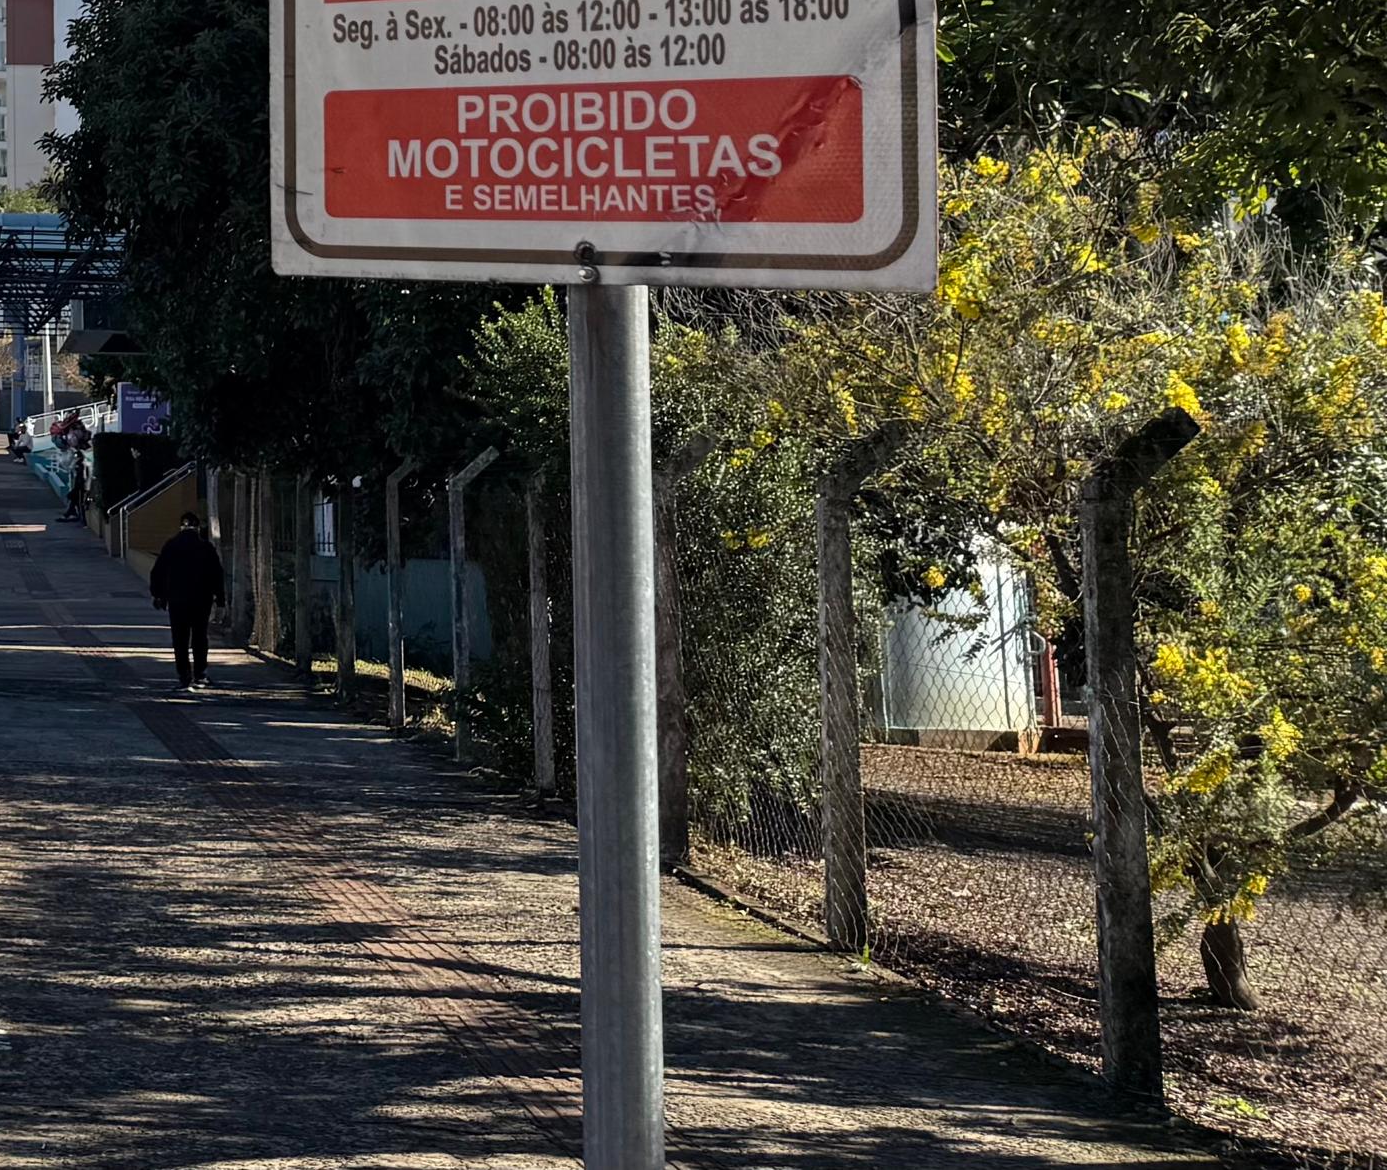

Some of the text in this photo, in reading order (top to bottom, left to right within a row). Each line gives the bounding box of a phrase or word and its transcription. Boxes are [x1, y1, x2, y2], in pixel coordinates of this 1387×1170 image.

[333, 13, 379, 49] Seg.
[386, 11, 398, 40] à
[405, 10, 452, 40] Sex.
[459, 22, 468, 30] -
[473, 3, 534, 37] 08:00
[542, 2, 569, 33] às
[648, 10, 658, 20] -
[434, 33, 725, 75] Sábados - 08:00 às 12:00
[457, 89, 696, 133] PROIBIDO
[388, 134, 782, 178] MOTOCICLETAS
[445, 184, 716, 213] E SEMELHANTES
